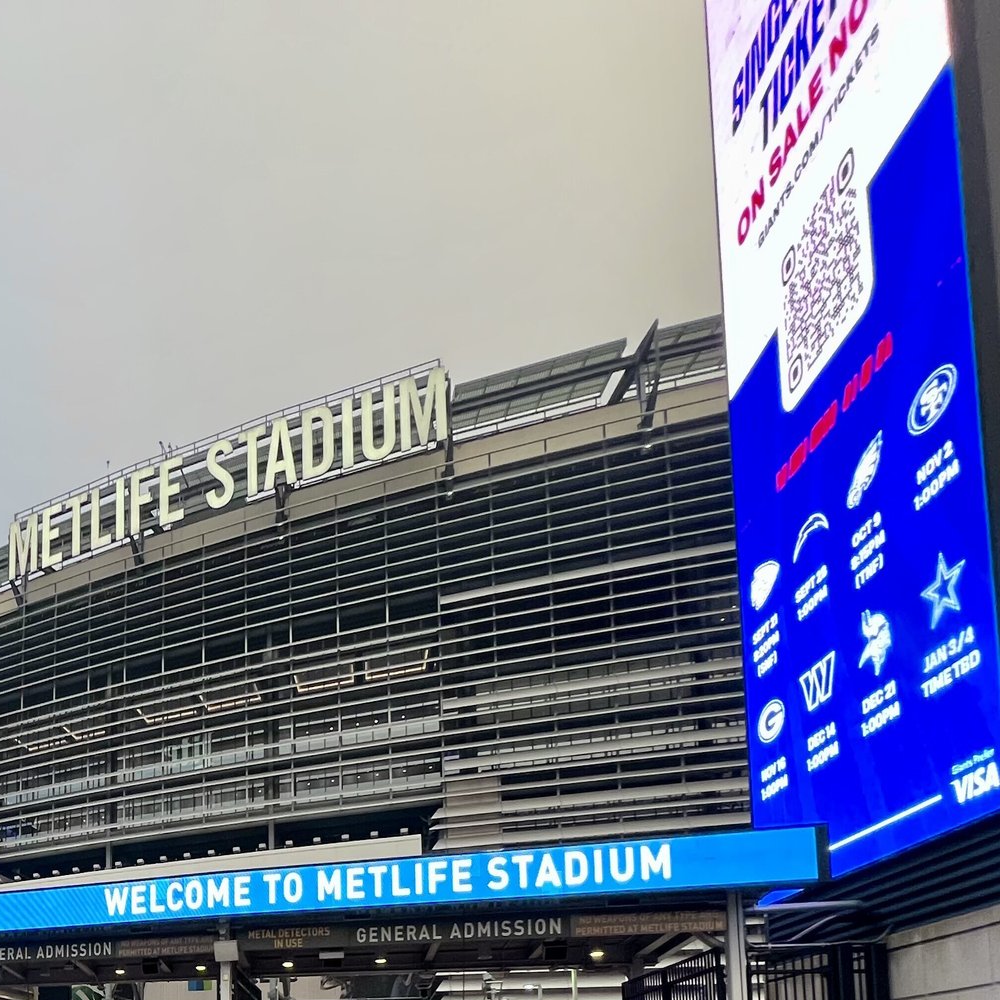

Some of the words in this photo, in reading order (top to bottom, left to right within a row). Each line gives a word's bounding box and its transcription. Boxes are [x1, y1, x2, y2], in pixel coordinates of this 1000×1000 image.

[732, 0, 797, 137] SINGL
[760, 0, 837, 151] TICKE
[737, 175, 764, 246] ON
[769, 62, 823, 187] SALE
[828, 0, 868, 76] NO
[757, 22, 880, 248] GIANTS.COM/TICKETS
[8, 456, 185, 581] METLIFE
[205, 366, 448, 510] STADIUM
[913, 458, 960, 511] 1:00PM
[916, 450, 943, 485] NOV
[851, 518, 873, 548] OCT
[797, 584, 828, 621] 1:00PM
[920, 664, 953, 698] TIME
[953, 649, 982, 678] TBD
[923, 647, 948, 673] JAN
[860, 700, 900, 737] 1:00PM
[861, 688, 884, 715] DEC
[806, 741, 839, 772] 1:00PM
[807, 730, 825, 752] DEC
[949, 761, 1000, 804] VISA
[104, 875, 252, 917] WELCOME
[263, 871, 303, 904] TO
[317, 857, 473, 901] METLIFE
[487, 843, 672, 891] STADIUM
[248, 929, 277, 939] METAL
[278, 926, 331, 938] DETECTORS
[273, 939, 283, 948] IN
[285, 938, 304, 948] USE
[356, 922, 442, 944] GENERAL
[449, 917, 562, 940] ADMISSION
[575, 924, 626, 935] PERMITTED
[627, 924, 639, 934] AT
[640, 922, 680, 933] METLIFE
[682, 920, 724, 931] STADIUM
[36, 941, 112, 959] ADMISSION
